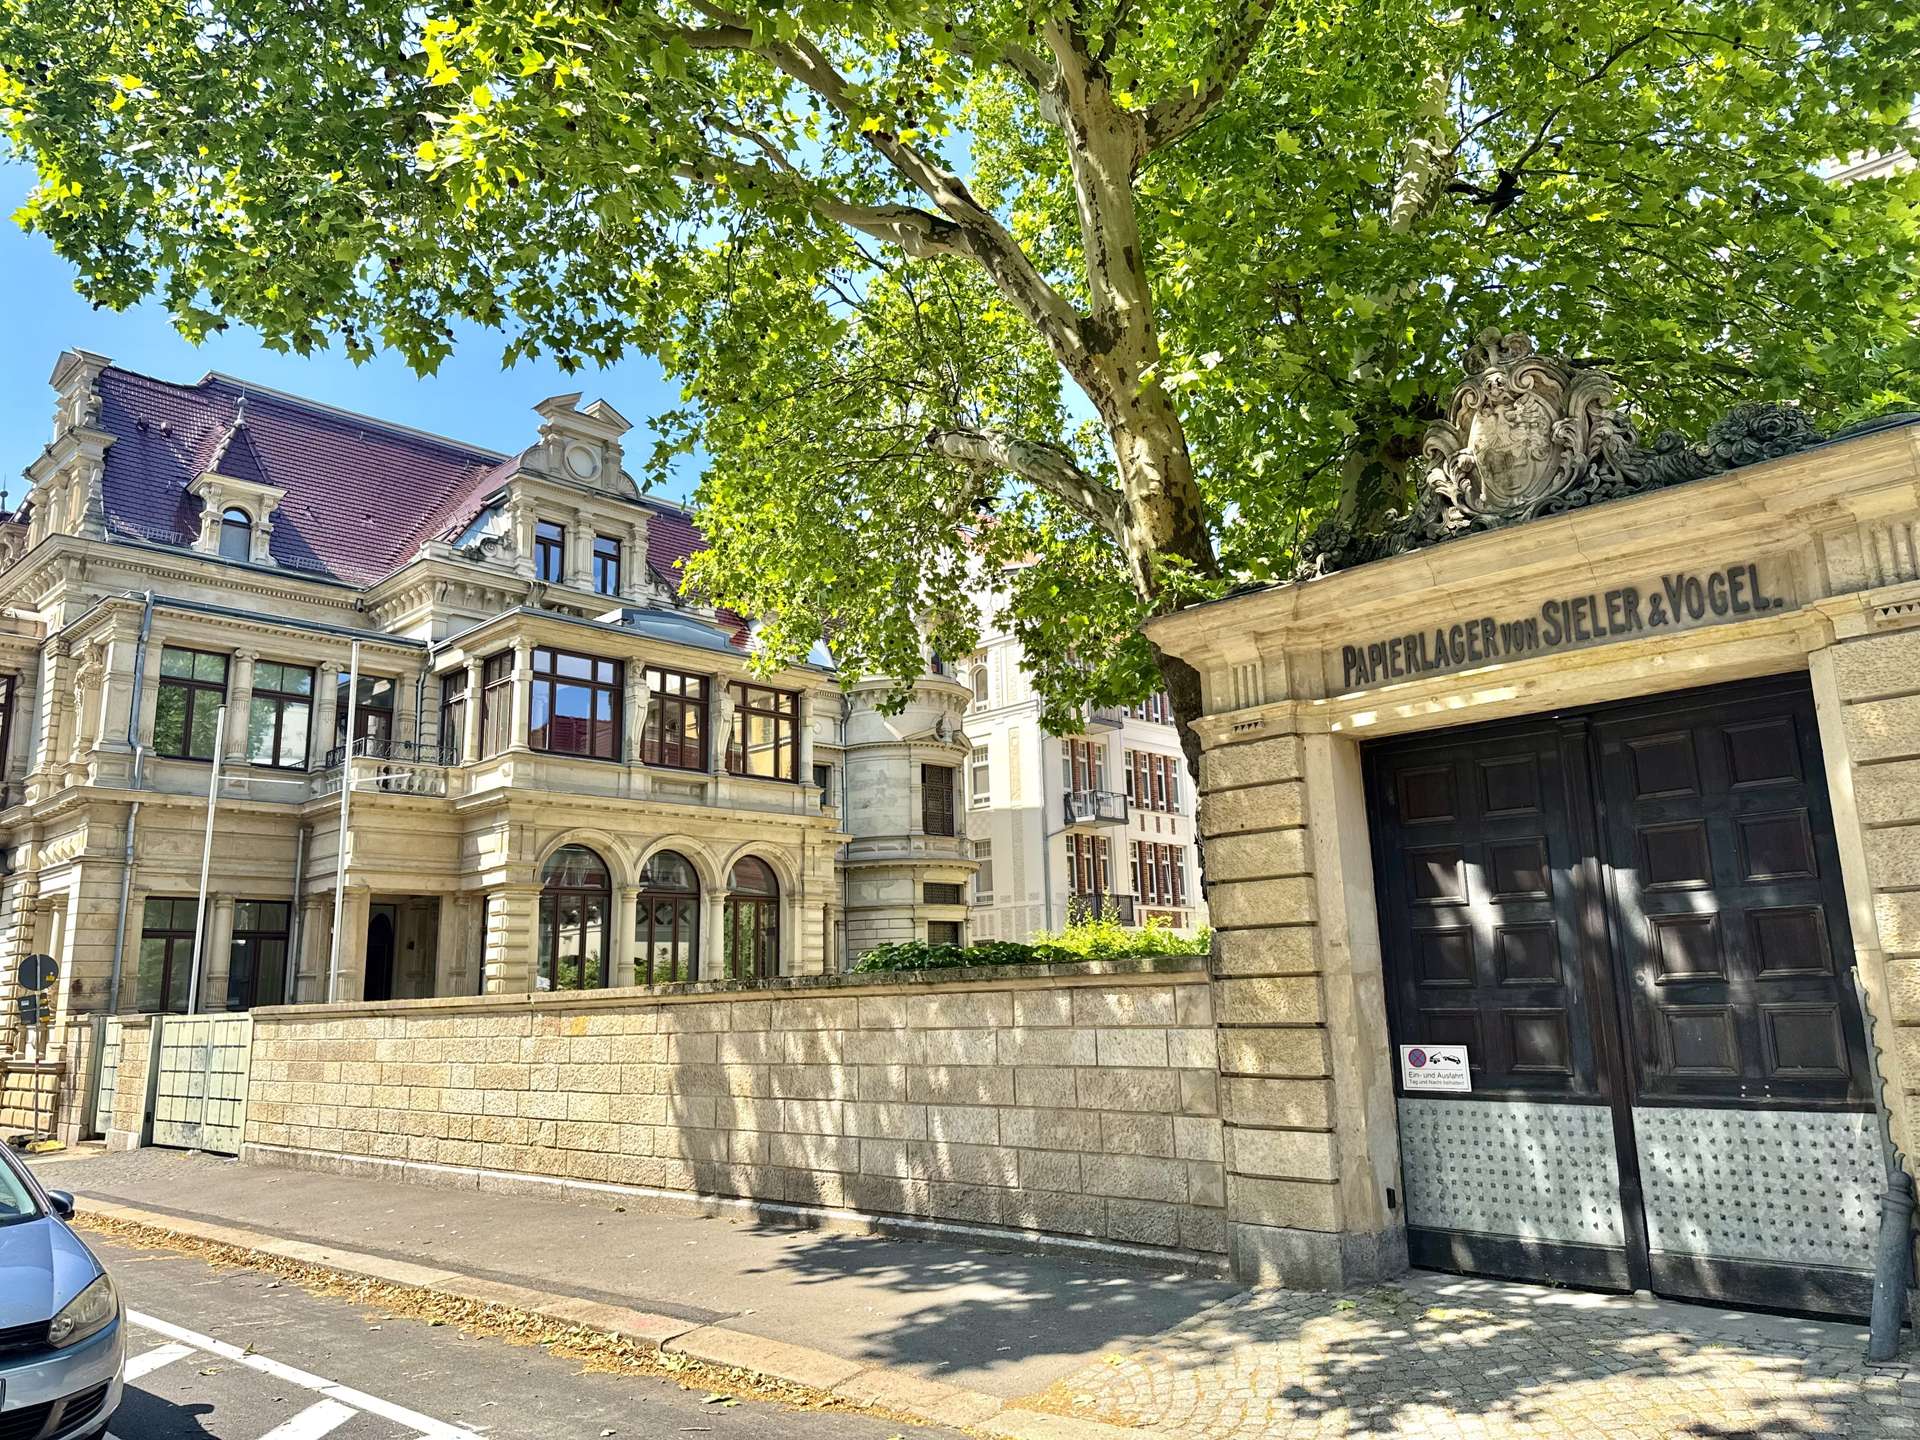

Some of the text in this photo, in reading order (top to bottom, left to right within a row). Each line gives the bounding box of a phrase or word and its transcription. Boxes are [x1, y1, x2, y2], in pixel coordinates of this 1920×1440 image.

[1342, 616, 1500, 688] PAPIERLAGER
[1500, 617, 1540, 655] VON
[1541, 586, 1644, 647] SIELER
